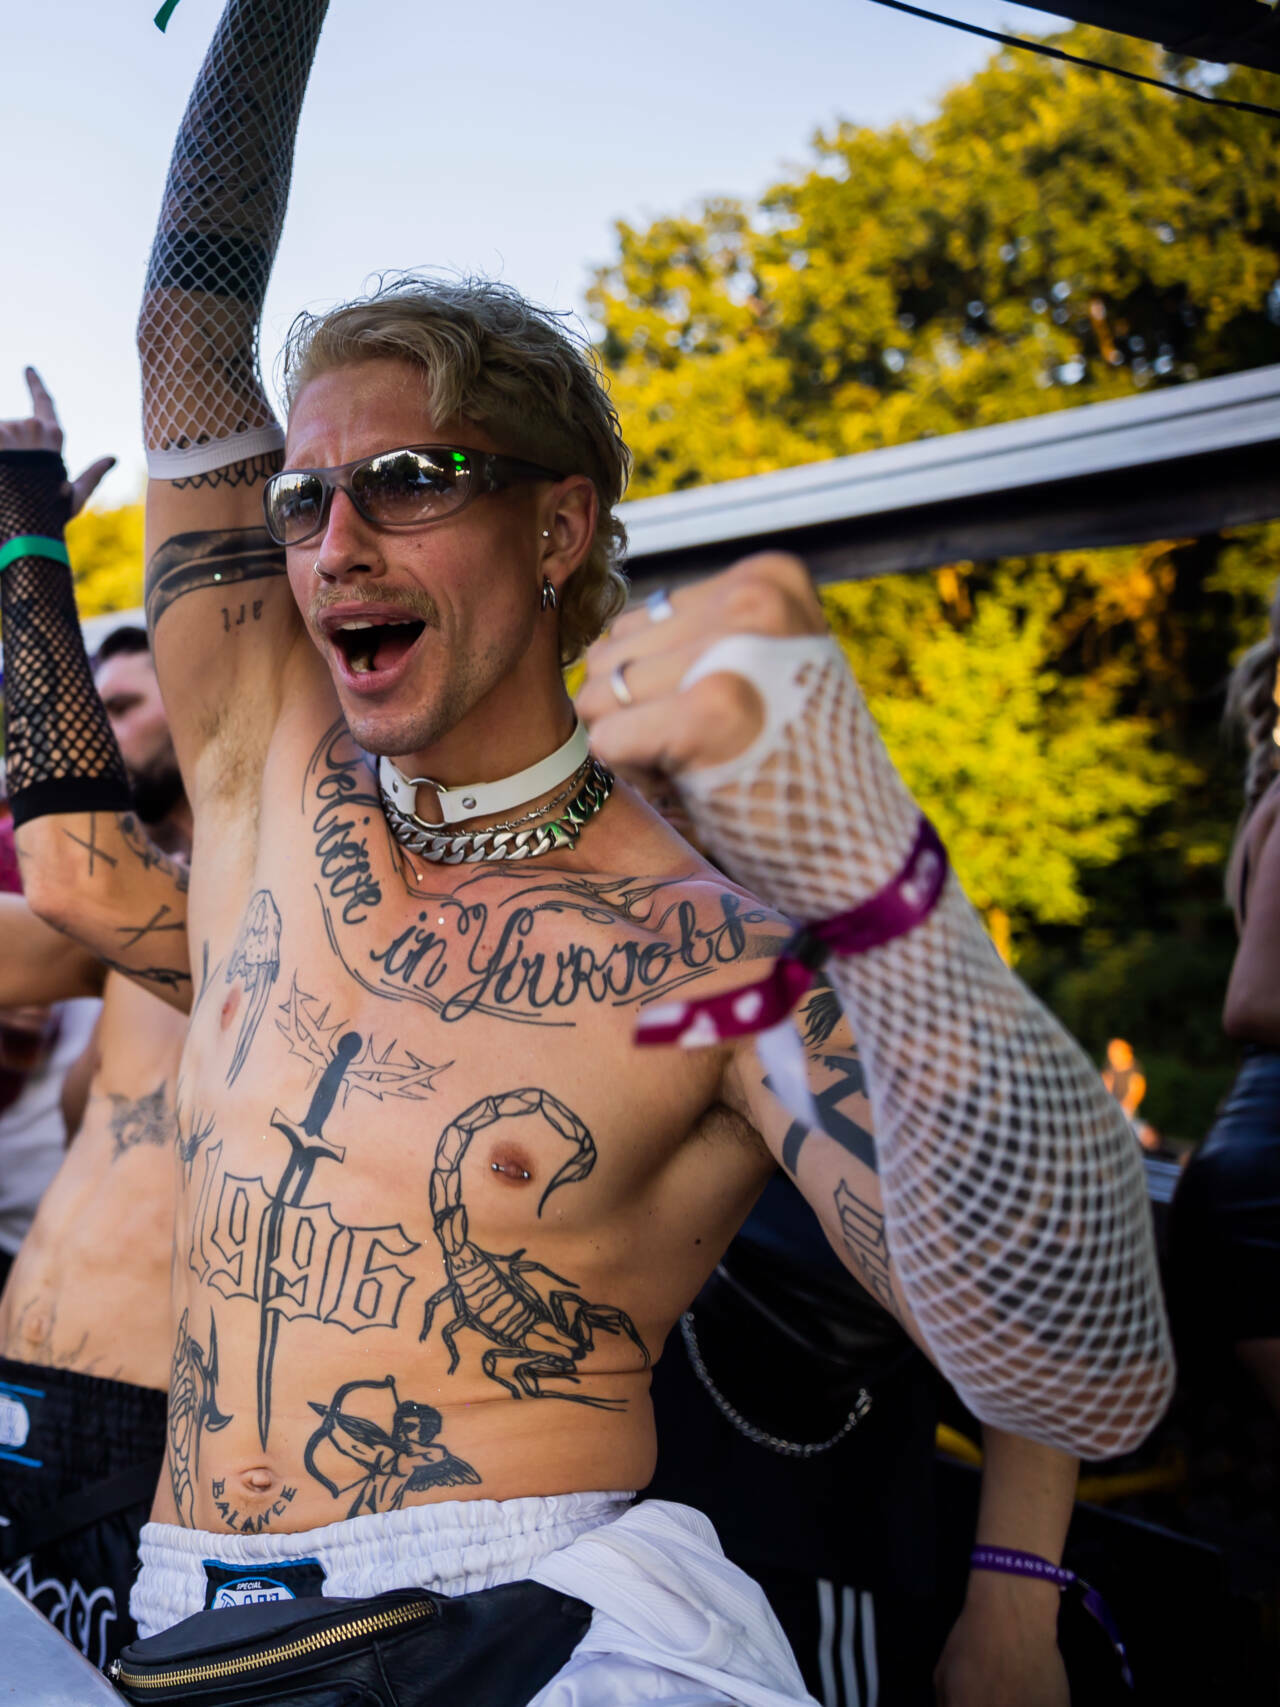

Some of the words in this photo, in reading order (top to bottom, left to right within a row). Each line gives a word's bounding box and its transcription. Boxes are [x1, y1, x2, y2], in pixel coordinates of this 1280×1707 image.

[370, 911, 448, 988] in
[189, 1138, 422, 1334] 1996
[211, 1477, 298, 1533] BALANCE
[236, 1581, 262, 1591] SPECIAL
